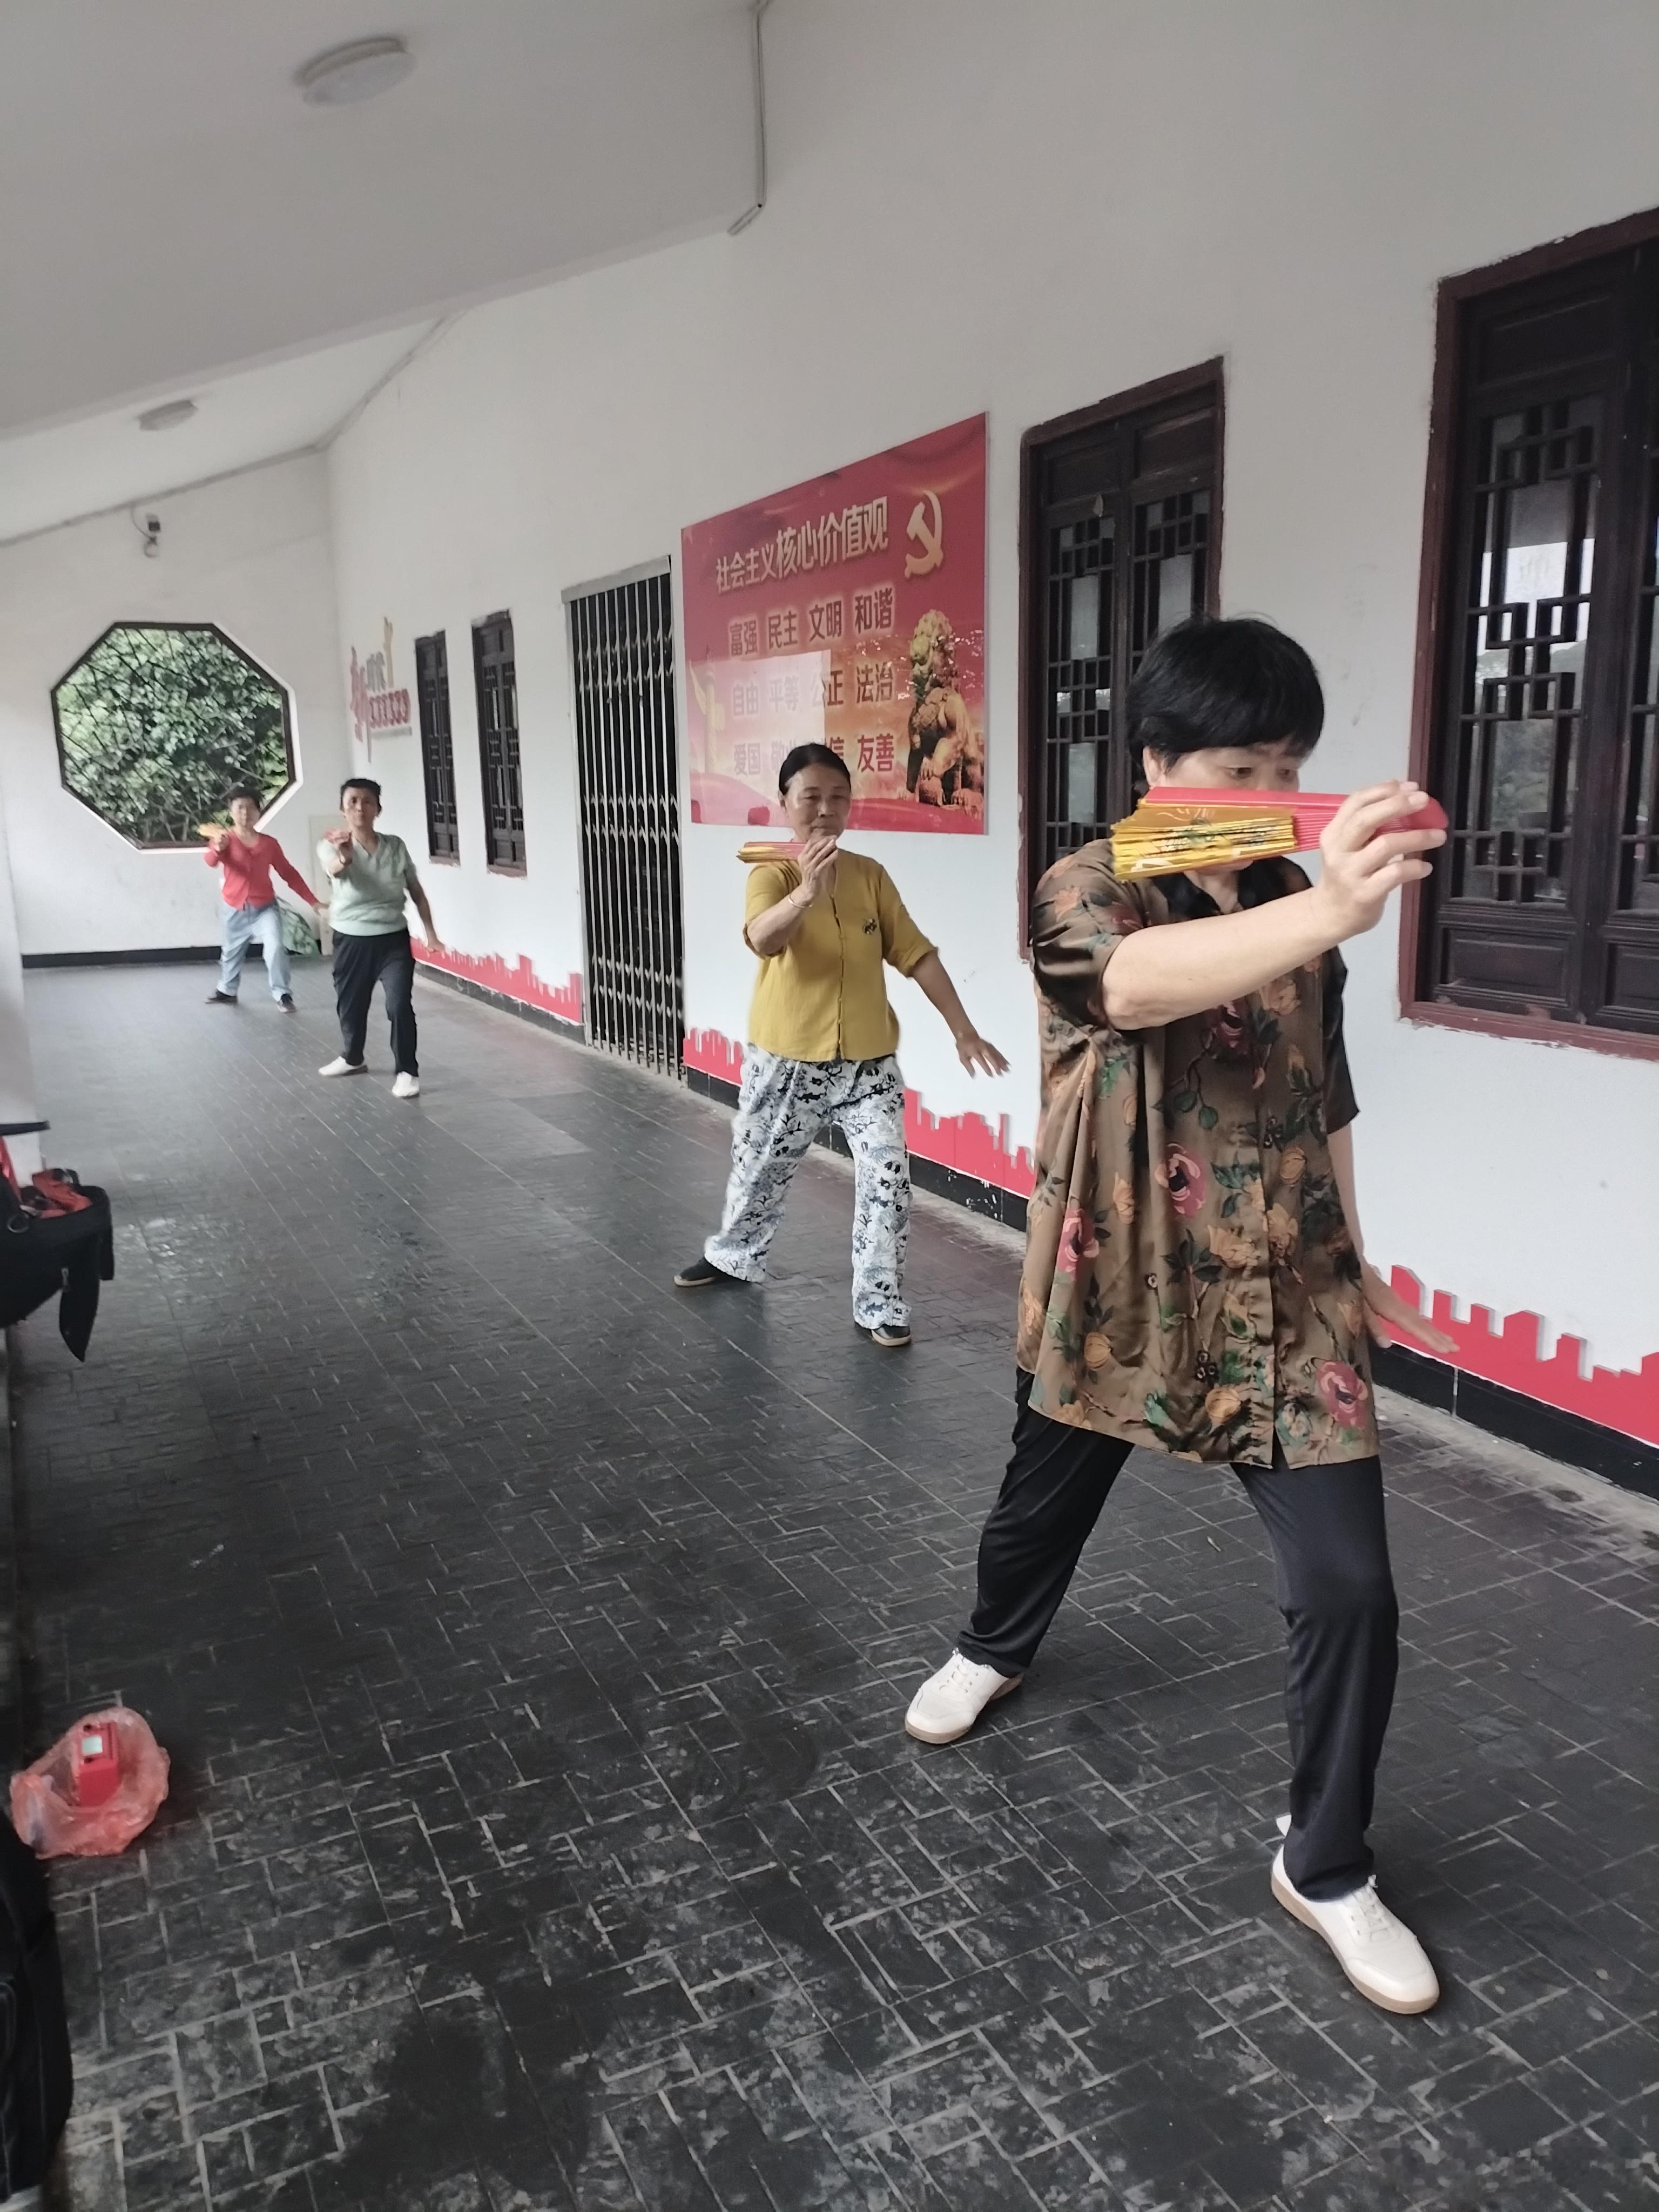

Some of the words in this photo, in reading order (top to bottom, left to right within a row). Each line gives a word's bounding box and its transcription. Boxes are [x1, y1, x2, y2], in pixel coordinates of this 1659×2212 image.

[716, 496, 888, 594] 社会主义核心价值观
[730, 621, 758, 656] 富强
[768, 611, 798, 649] 民主
[809, 601, 842, 642] 文明
[855, 588, 893, 633] 和谐
[733, 683, 758, 716] 自由
[769, 676, 799, 712] 平等
[857, 662, 893, 704] 法治
[734, 743, 760, 776] 爱国
[858, 733, 894, 773] 友善
